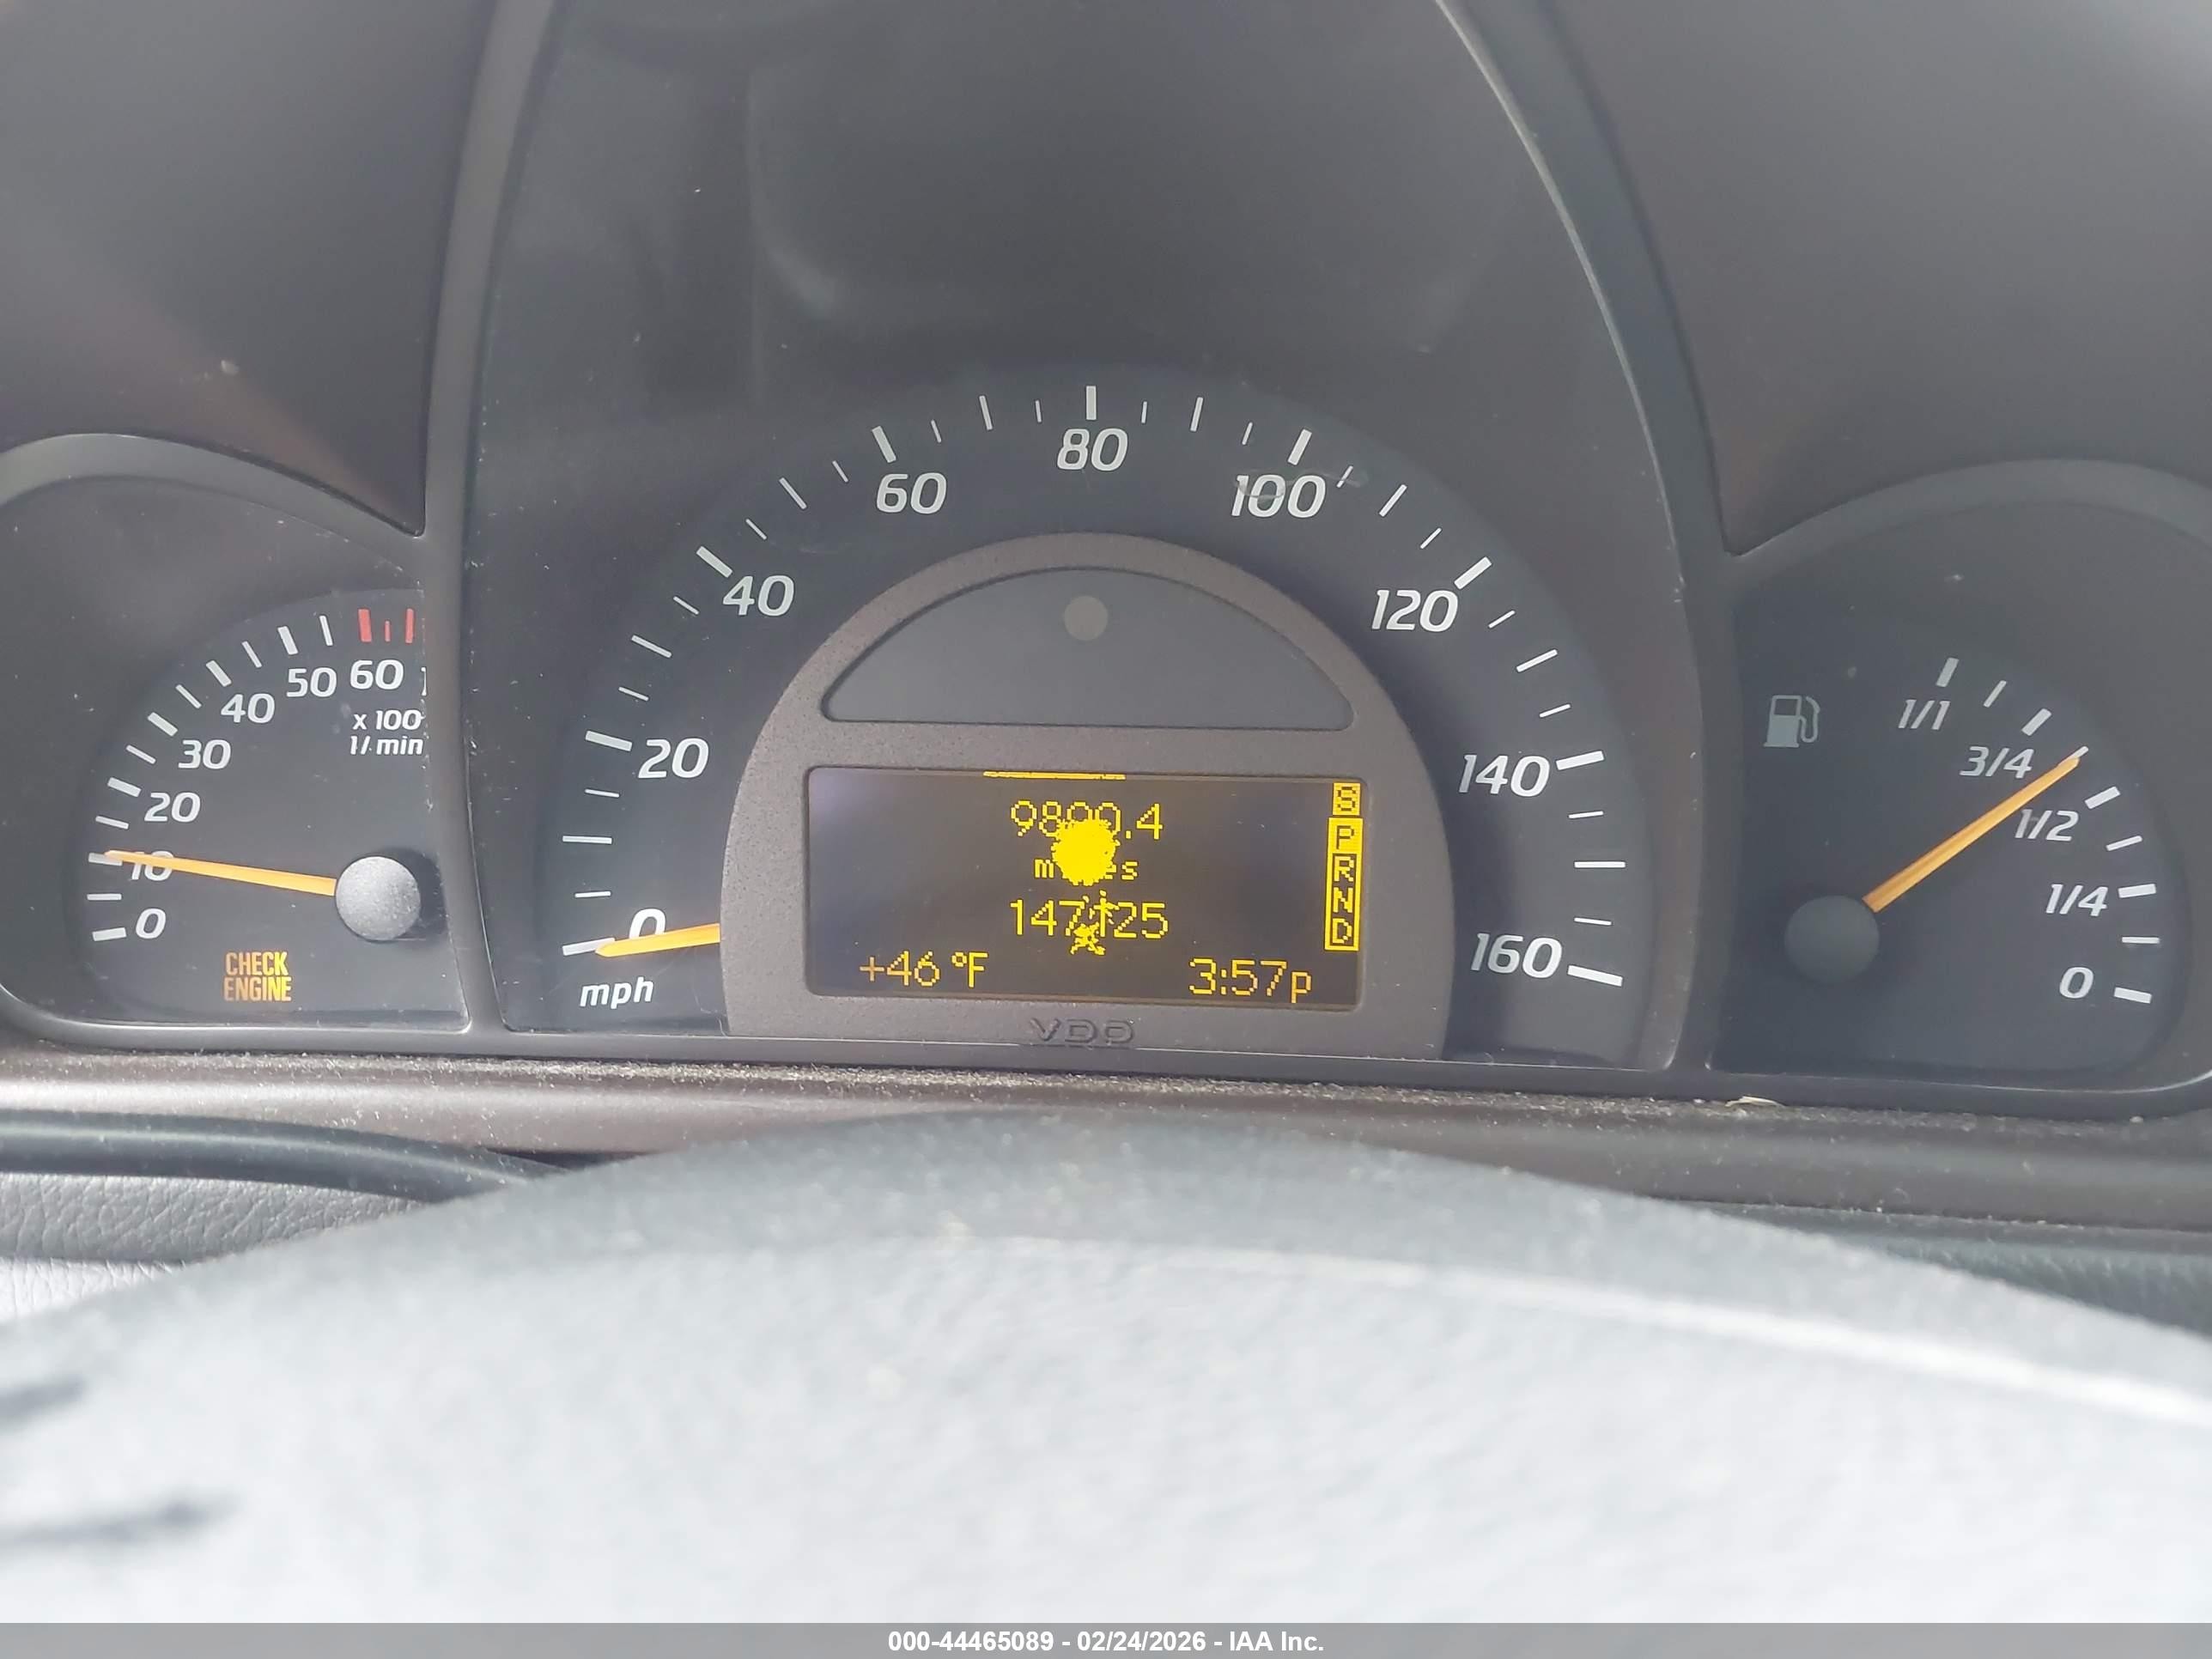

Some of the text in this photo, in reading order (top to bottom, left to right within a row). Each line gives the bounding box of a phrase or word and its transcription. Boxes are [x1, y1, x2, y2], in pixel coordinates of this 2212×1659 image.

[1057, 428, 1127, 471] 80
[876, 472, 946, 514] 60
[1231, 474, 1326, 518] 100
[722, 574, 794, 617] 40
[1371, 589, 1458, 632] 120
[286, 667, 337, 697] 50
[349, 659, 404, 690] 60
[220, 693, 275, 723] 40
[375, 709, 422, 731] 100
[1898, 699, 1951, 731] 1/1
[177, 739, 231, 769] 30
[638, 737, 709, 779] 20
[1959, 745, 2035, 778] 3/4
[1459, 754, 1550, 798] 140
[143, 792, 201, 823] 20
[2014, 810, 2079, 842] 1/2
[129, 850, 174, 882] 10
[2045, 884, 2109, 916] 1/4
[136, 908, 167, 939] 0
[628, 908, 667, 940] 0
[225, 951, 289, 977] CHECK
[1470, 933, 1563, 979] 160
[223, 976, 292, 1002] ENGINE
[579, 976, 654, 1010] mph
[2058, 967, 2094, 1000] 0
[1030, 1018, 1133, 1044] VDO
